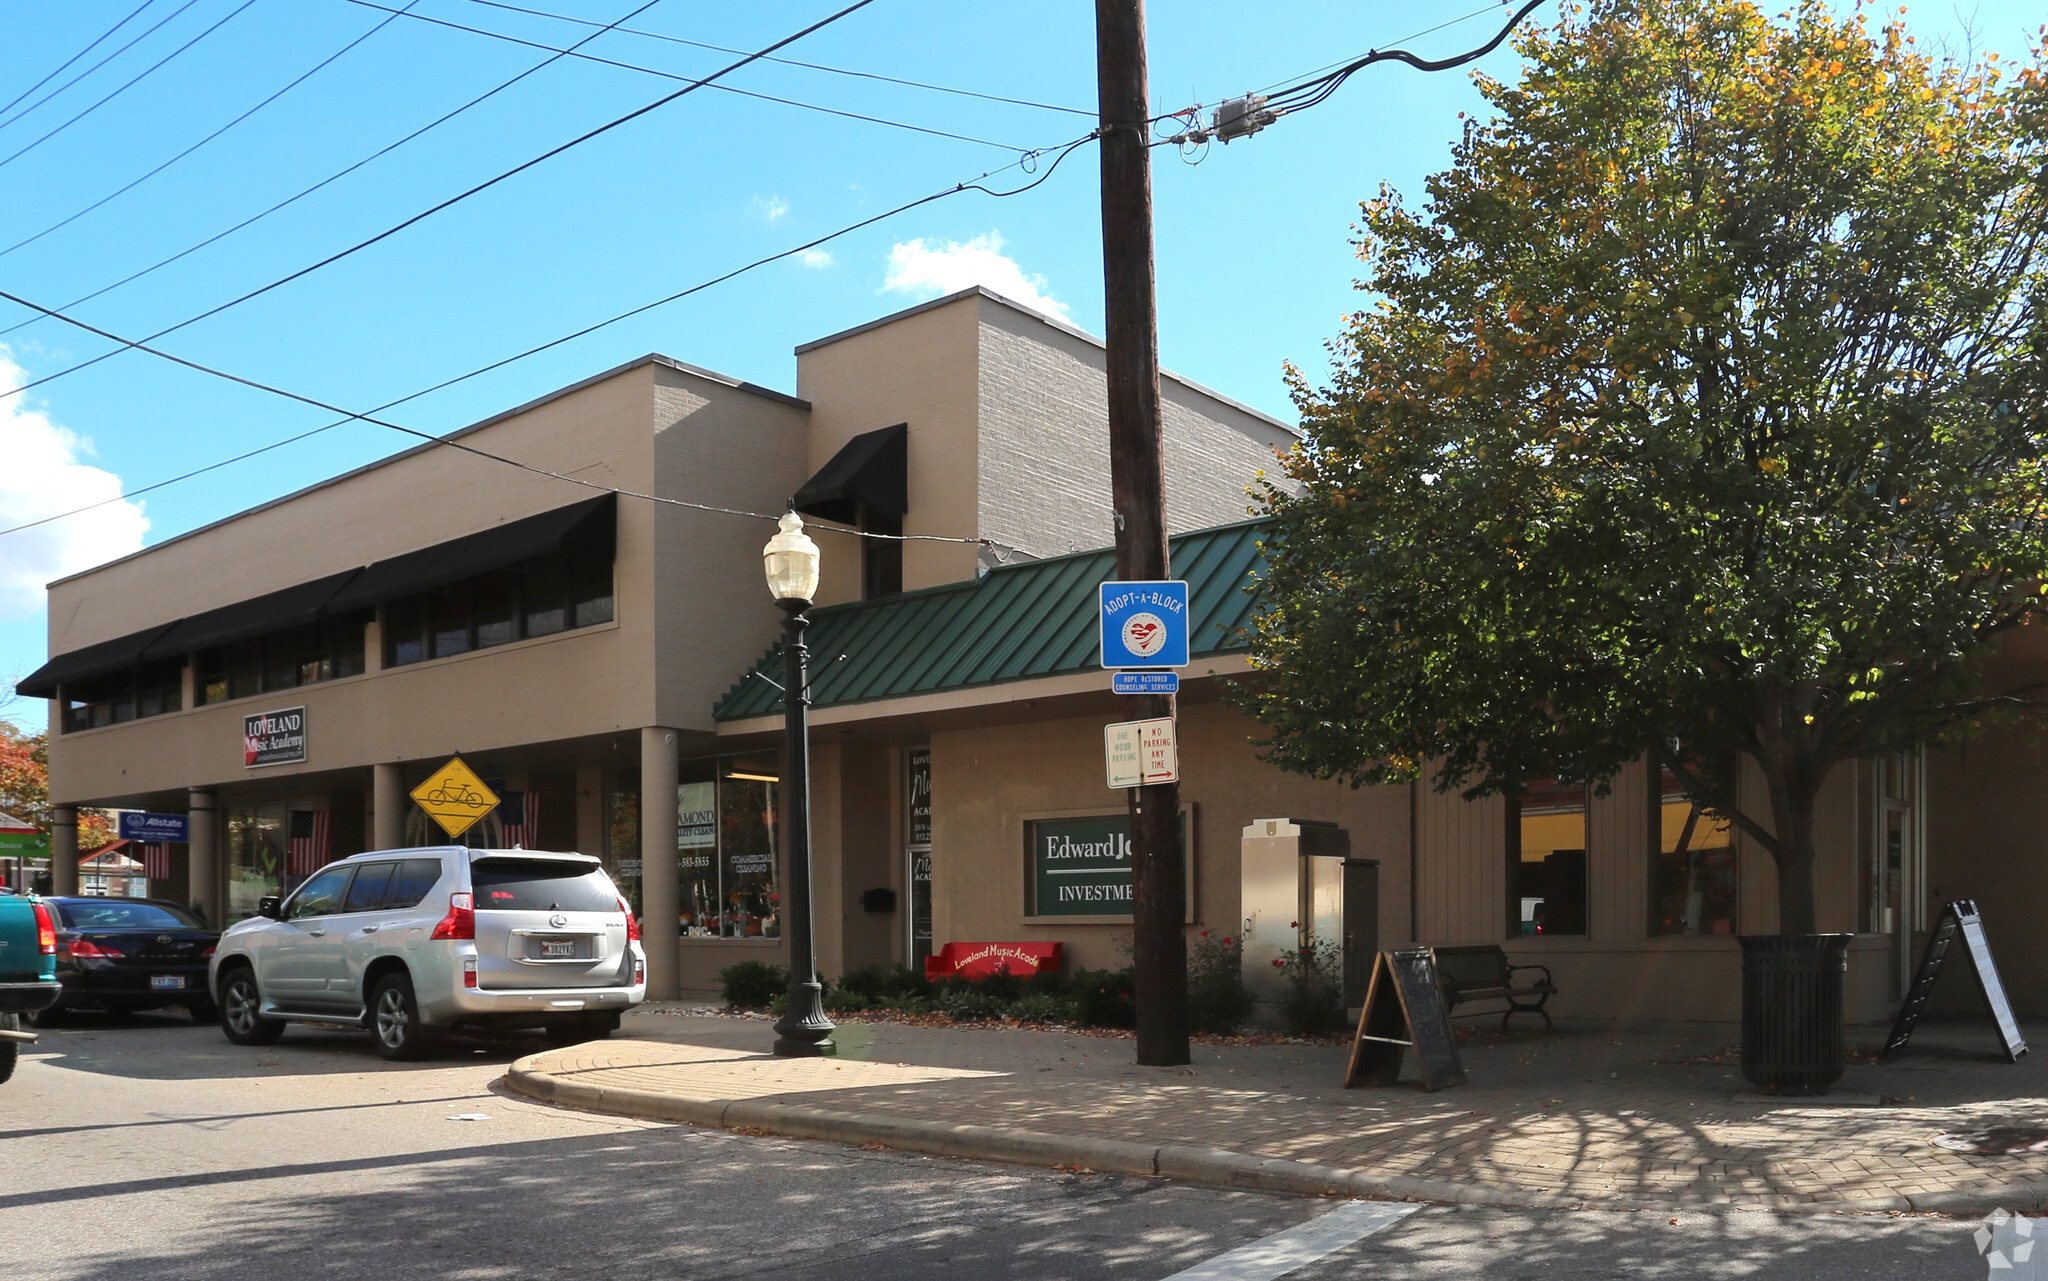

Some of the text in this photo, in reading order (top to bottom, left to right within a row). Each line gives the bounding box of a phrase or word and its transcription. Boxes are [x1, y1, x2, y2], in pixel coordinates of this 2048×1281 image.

[1104, 592, 1185, 616] ADOPT-A-BLOCK
[1123, 675, 1168, 683] HOPE RESTORED
[1115, 683, 1176, 691] COUNSELING SERVICES
[248, 714, 301, 737] LOVELAND
[1116, 731, 1129, 741] ONE
[1151, 727, 1162, 736] NO
[269, 733, 304, 751] Academy
[1114, 742, 1132, 751] HOUR
[1143, 738, 1171, 748] PARKING
[1112, 753, 1137, 763] PARKING
[1151, 749, 1164, 759] ANY
[1151, 760, 1165, 769] TIME
[146, 817, 182, 828] Allstate
[954, 946, 989, 970] Loveland
[989, 944, 1014, 957] Music
